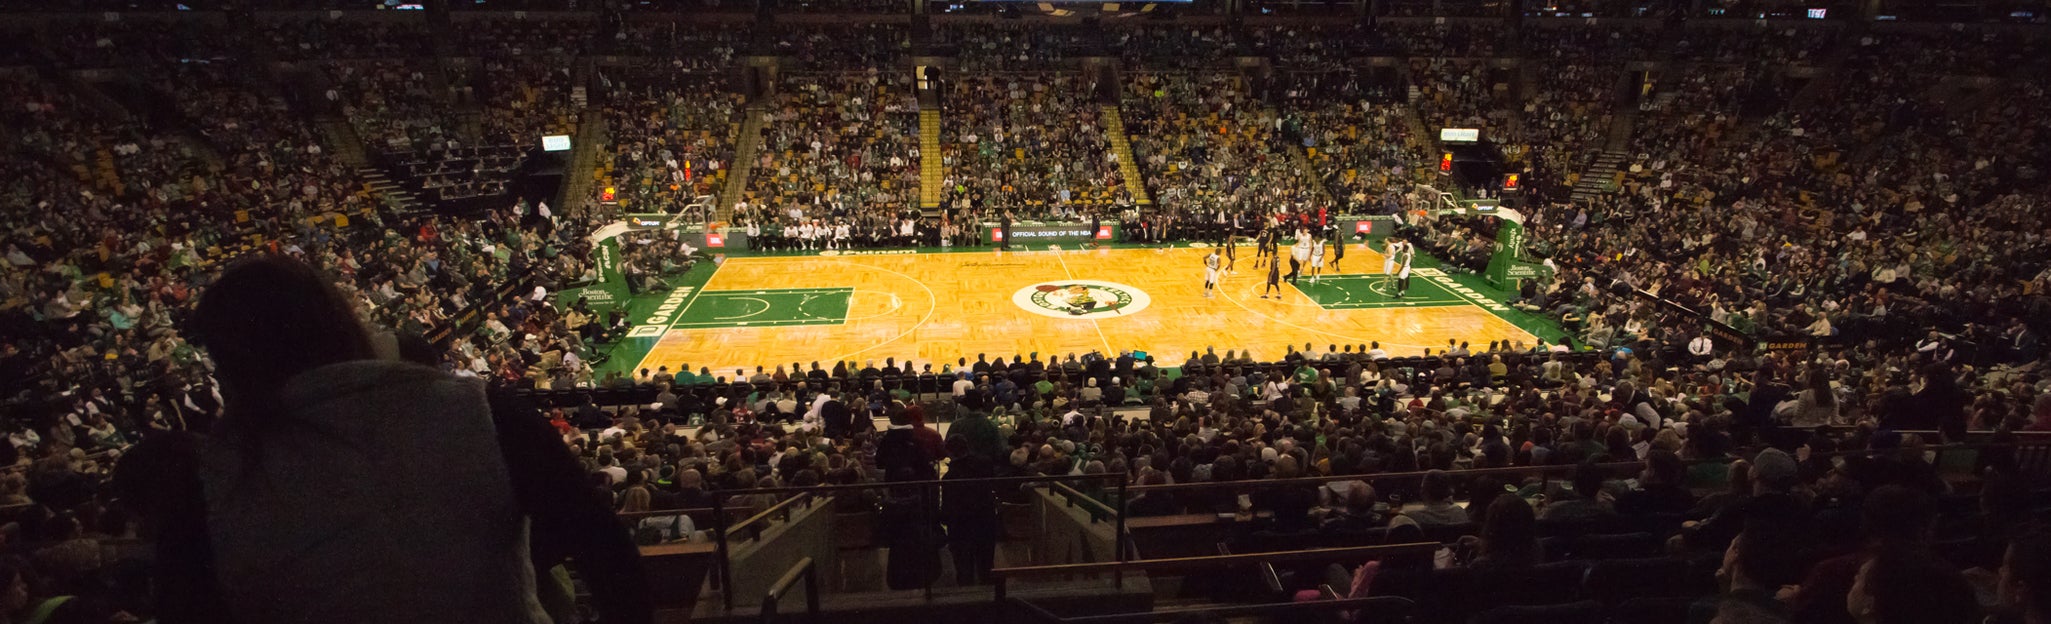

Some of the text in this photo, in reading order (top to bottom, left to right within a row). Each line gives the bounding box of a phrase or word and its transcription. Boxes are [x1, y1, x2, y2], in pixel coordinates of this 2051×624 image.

[646, 286, 695, 325] GARDEN
[1433, 276, 1510, 311] GARDEN
[1769, 342, 1808, 350] GARDEN
